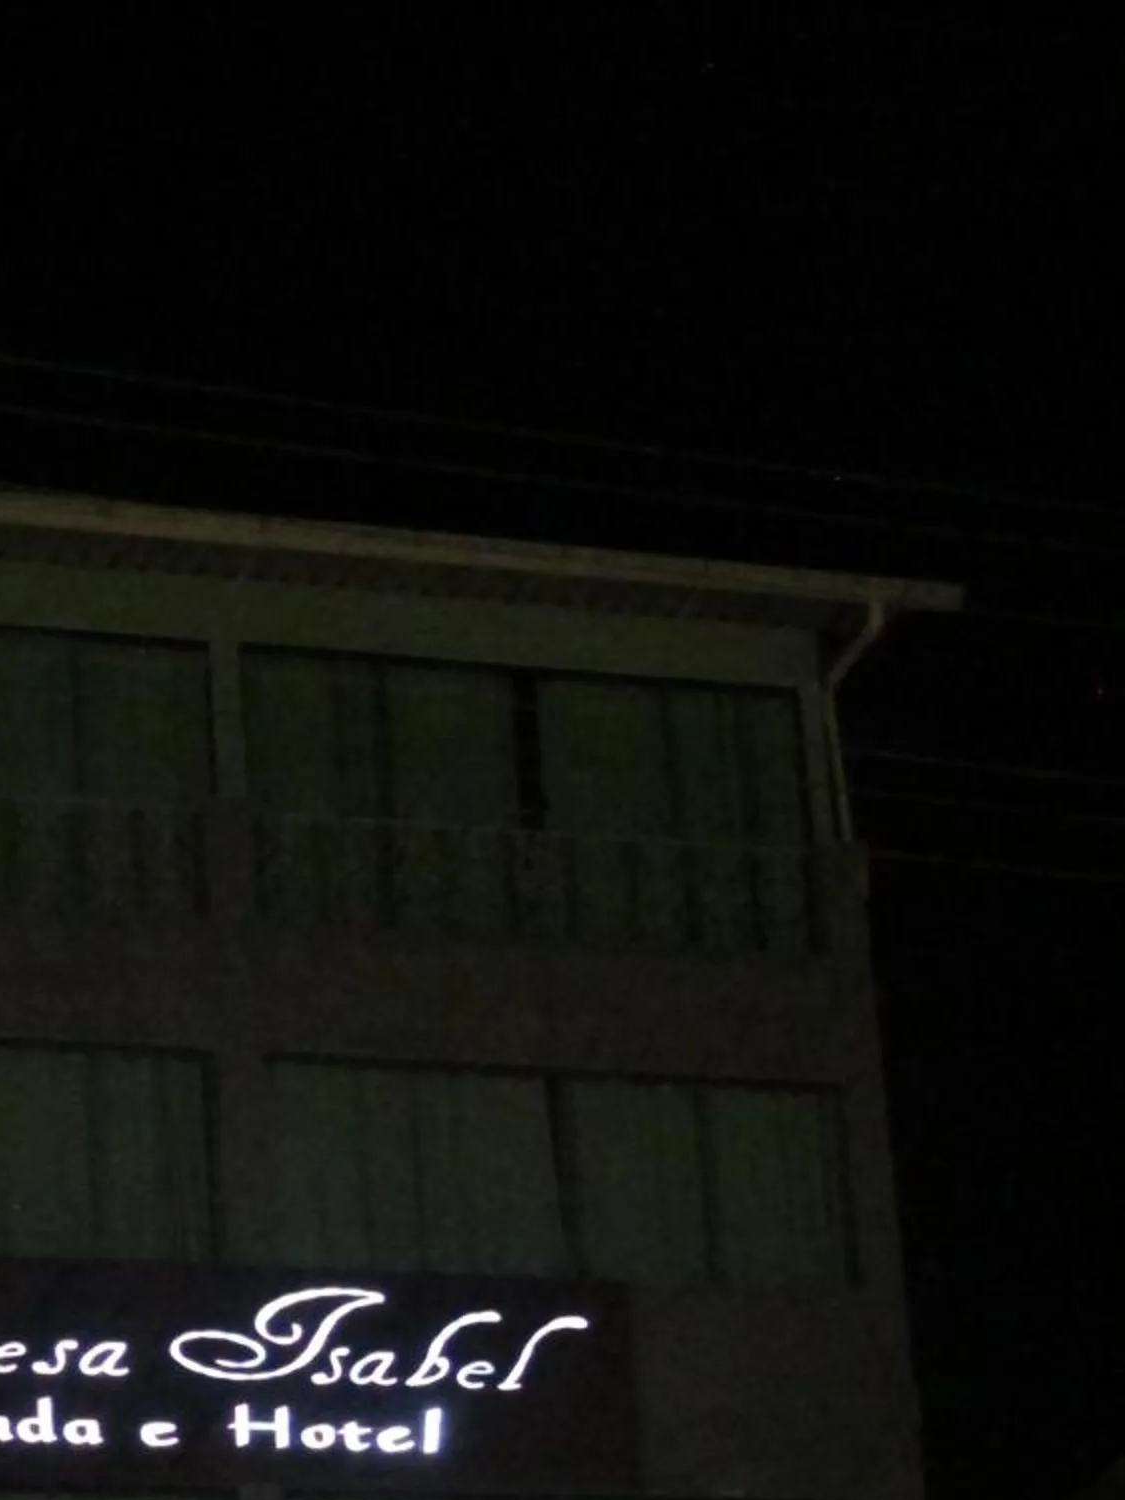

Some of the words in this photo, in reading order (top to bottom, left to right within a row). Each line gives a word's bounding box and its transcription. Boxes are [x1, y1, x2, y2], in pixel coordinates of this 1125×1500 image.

[168, 1285, 590, 1392] Isabel
[139, 1419, 181, 1449] e
[225, 1402, 446, 1456] Hotel
